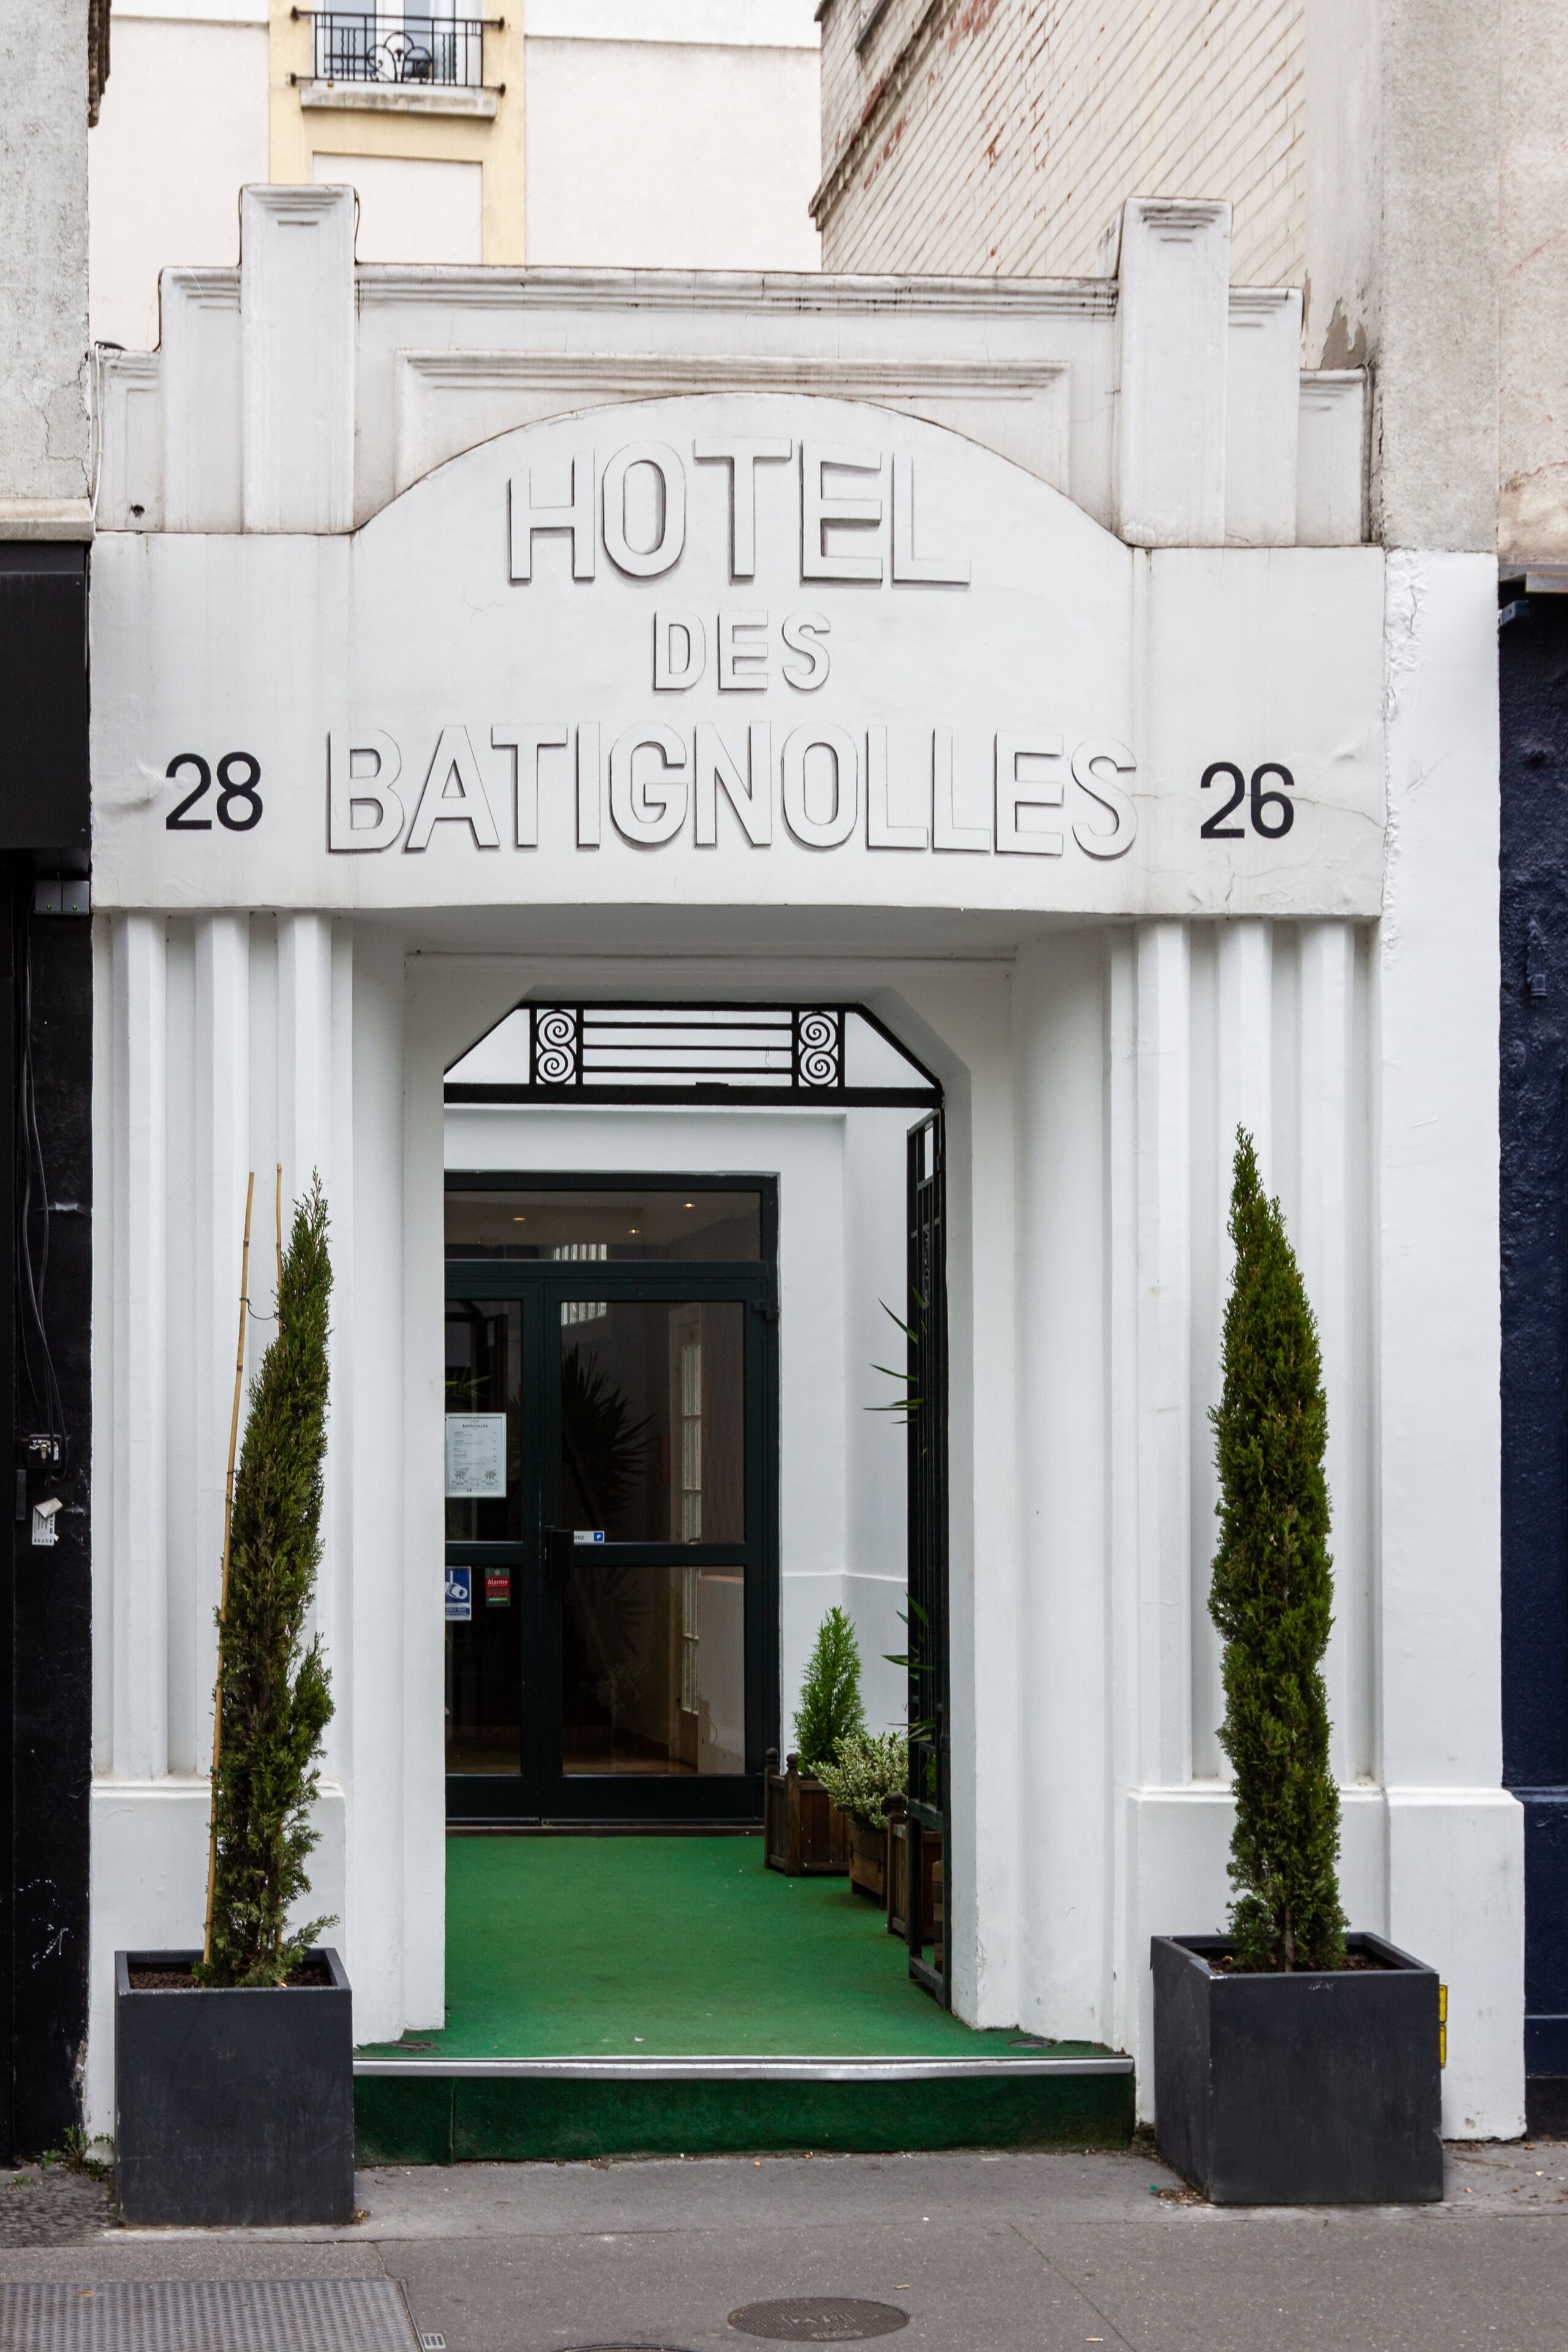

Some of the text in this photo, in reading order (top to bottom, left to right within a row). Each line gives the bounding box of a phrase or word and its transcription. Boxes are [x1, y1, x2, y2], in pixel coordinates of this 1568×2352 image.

[508, 437, 971, 586] HOTEL
[653, 609, 831, 693] DES
[165, 752, 263, 831] 28
[326, 721, 1139, 859] BATIGNOLLES
[1200, 762, 1294, 839] 26
